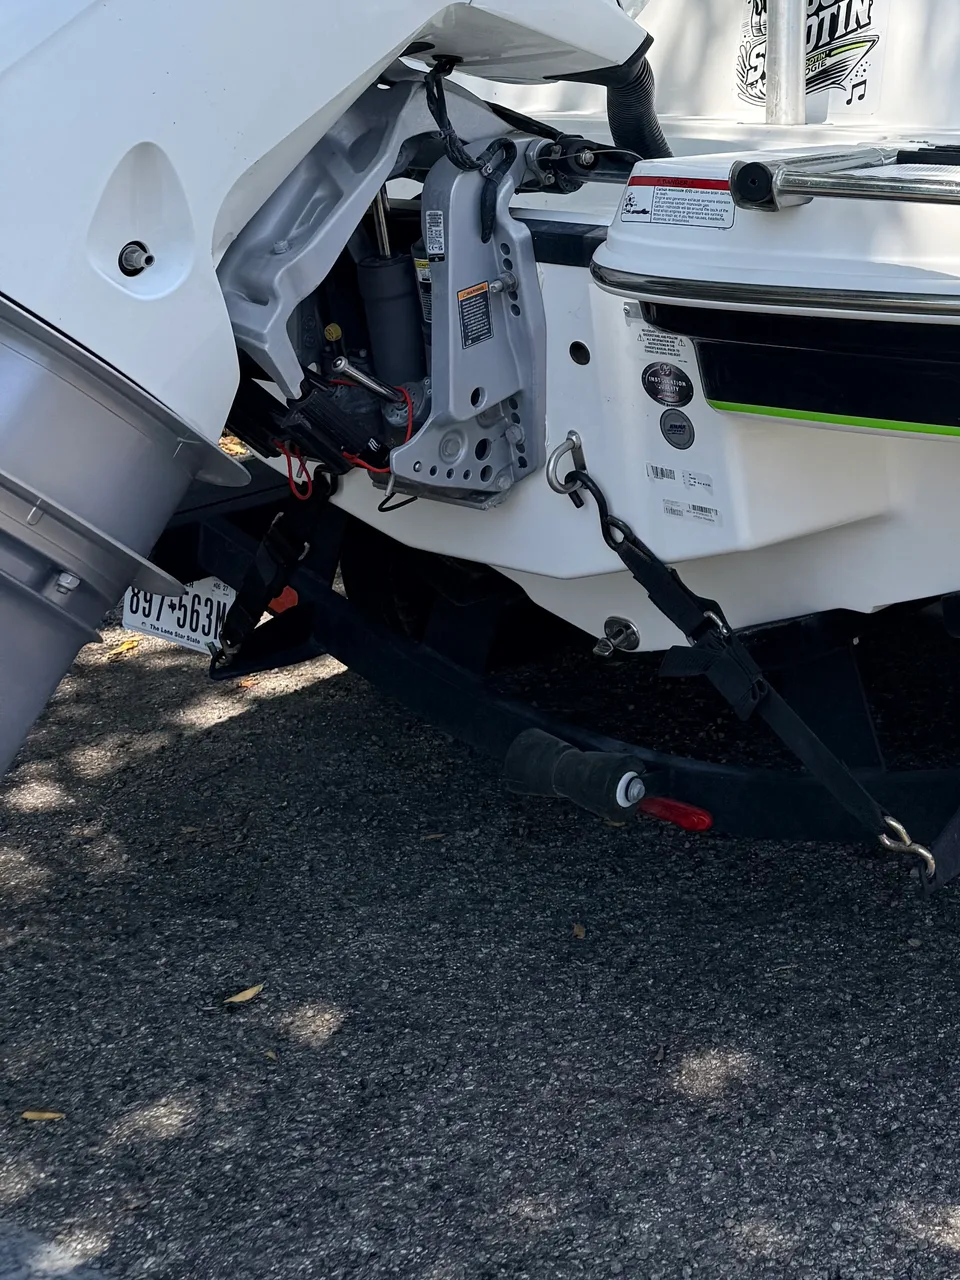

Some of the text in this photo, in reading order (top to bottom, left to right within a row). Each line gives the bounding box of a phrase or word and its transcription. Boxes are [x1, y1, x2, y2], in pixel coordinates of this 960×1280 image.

[150, 623, 200, 645] The Lone Star State
